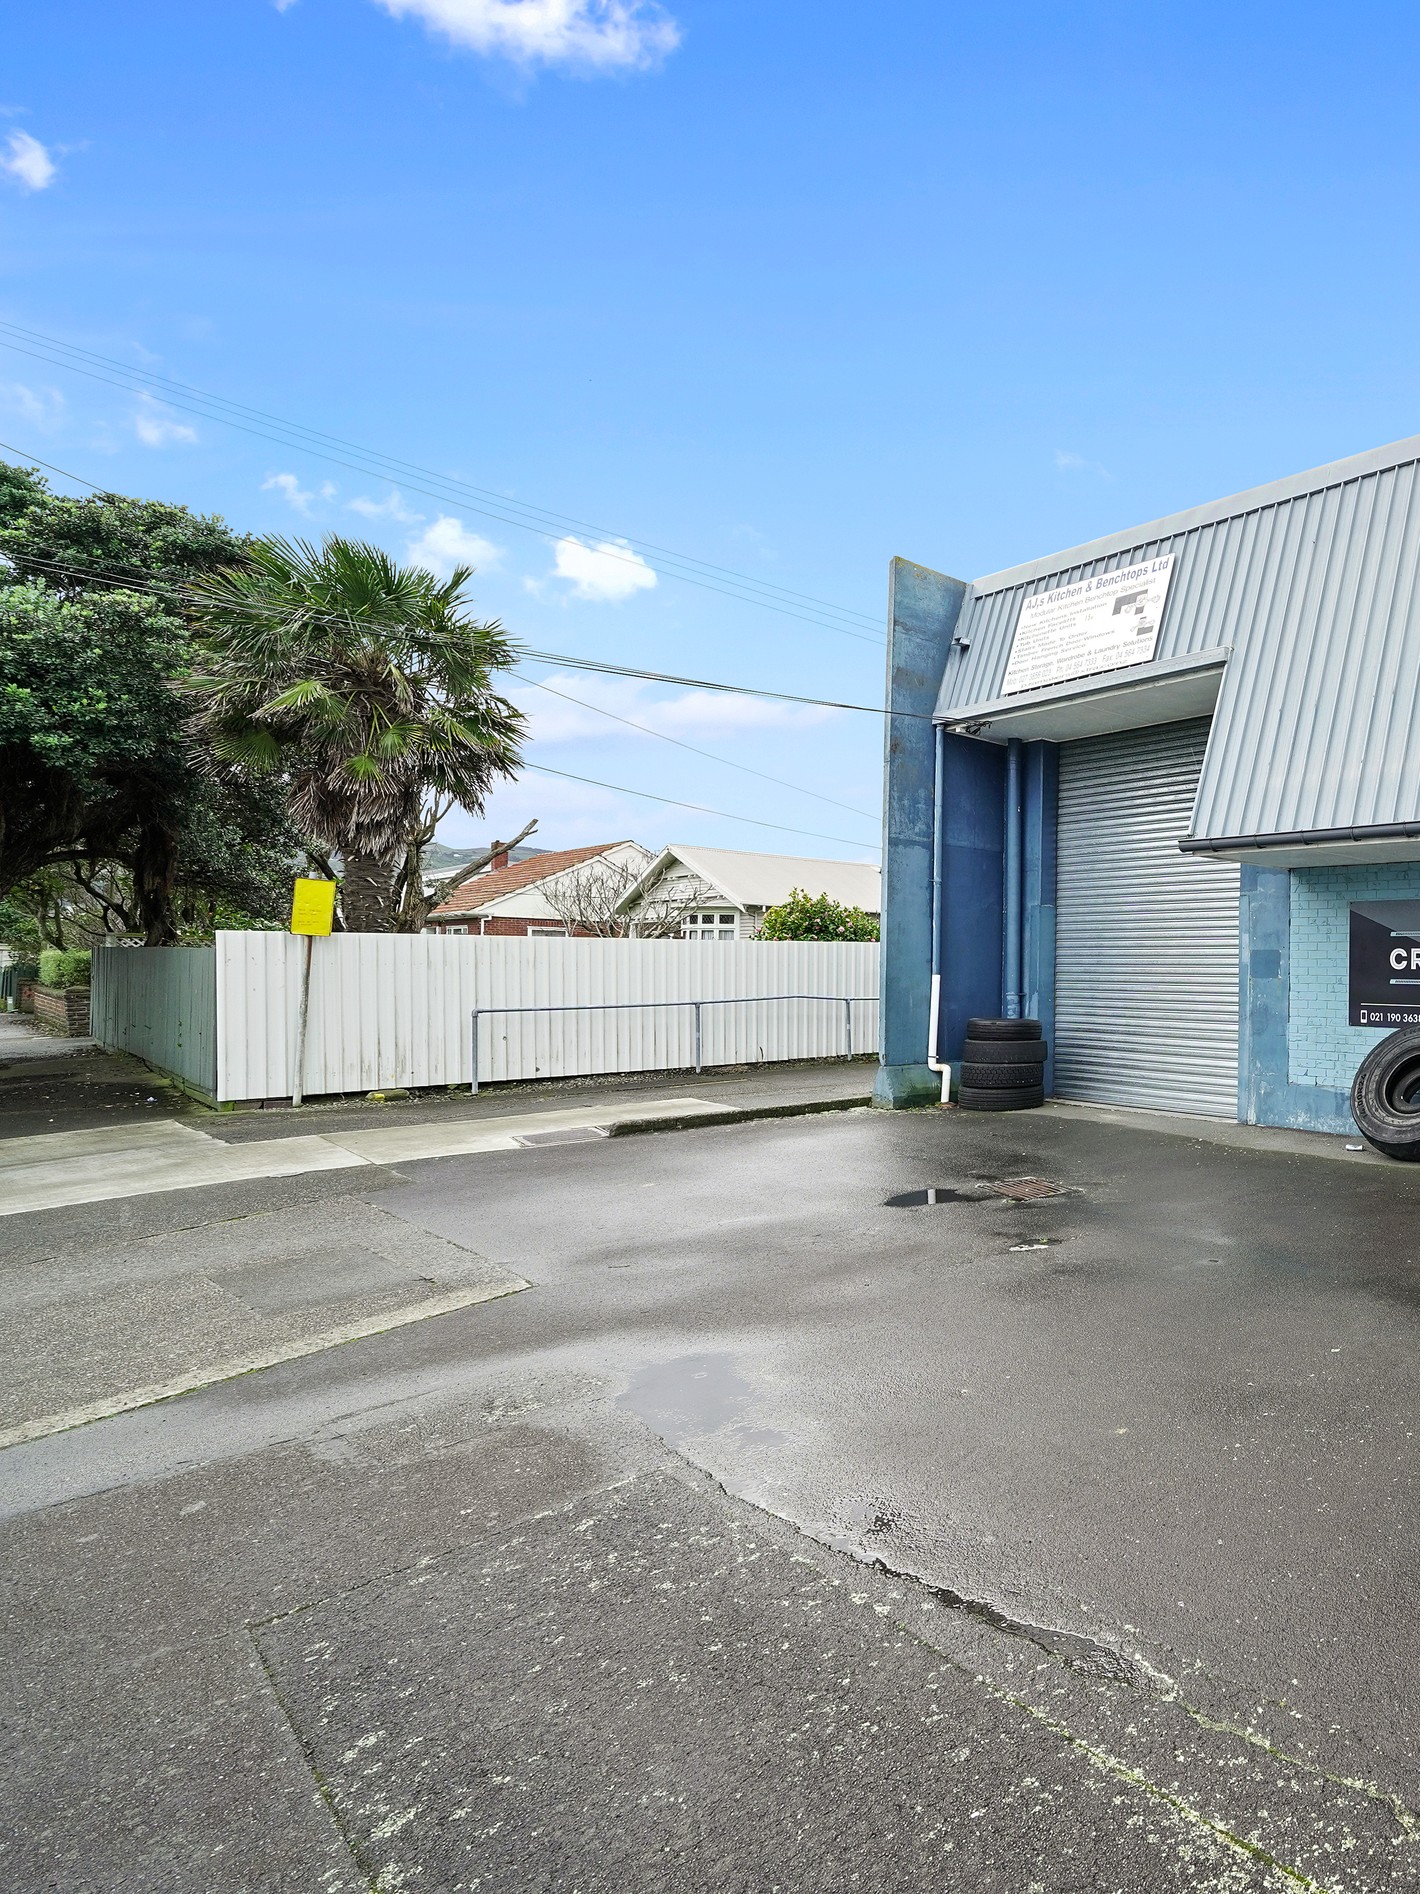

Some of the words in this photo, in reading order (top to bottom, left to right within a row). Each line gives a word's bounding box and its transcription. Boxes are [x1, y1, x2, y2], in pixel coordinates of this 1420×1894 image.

[1046, 586, 1082, 603] Kitchen
[1085, 580, 1092, 592] &
[1095, 566, 1148, 589] Benchtops
[1151, 557, 1170, 573] Ltd
[1030, 607, 1055, 618] Modular
[1057, 599, 1083, 610] Kitchen
[1084, 589, 1118, 603] Benchtop
[1119, 577, 1155, 592] Specialist
[1093, 644, 1120, 654] Laundry
[1122, 636, 1152, 647] Solutions
[1370, 1012, 1383, 1021] 021
[1387, 1013, 1401, 1022] 190
